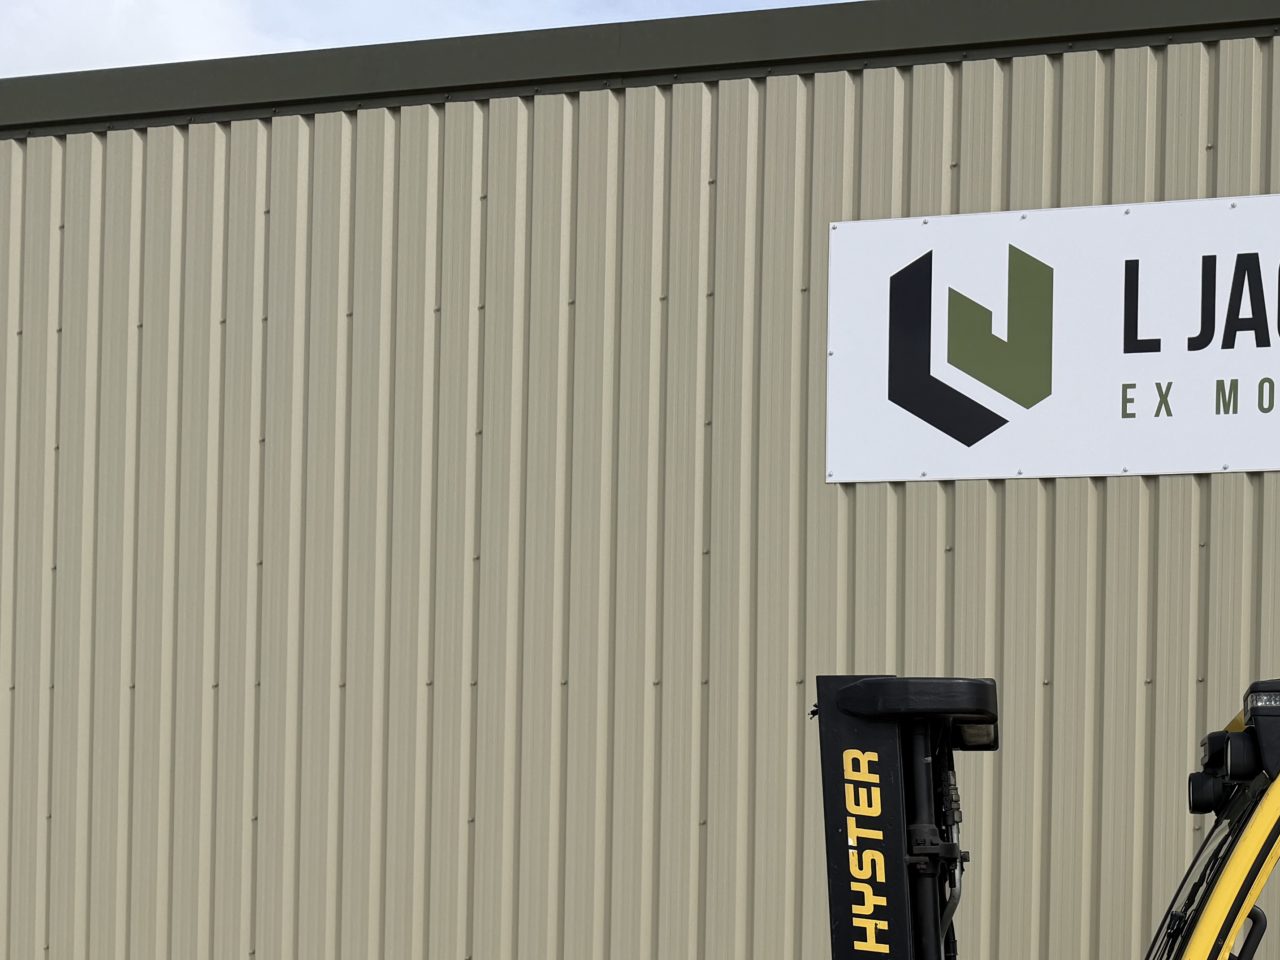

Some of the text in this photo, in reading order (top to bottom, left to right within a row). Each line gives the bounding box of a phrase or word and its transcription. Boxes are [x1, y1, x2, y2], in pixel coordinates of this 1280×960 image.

[1122, 258, 1162, 355] L
[1121, 381, 1173, 419] EX
[843, 748, 890, 954] HYSTER
